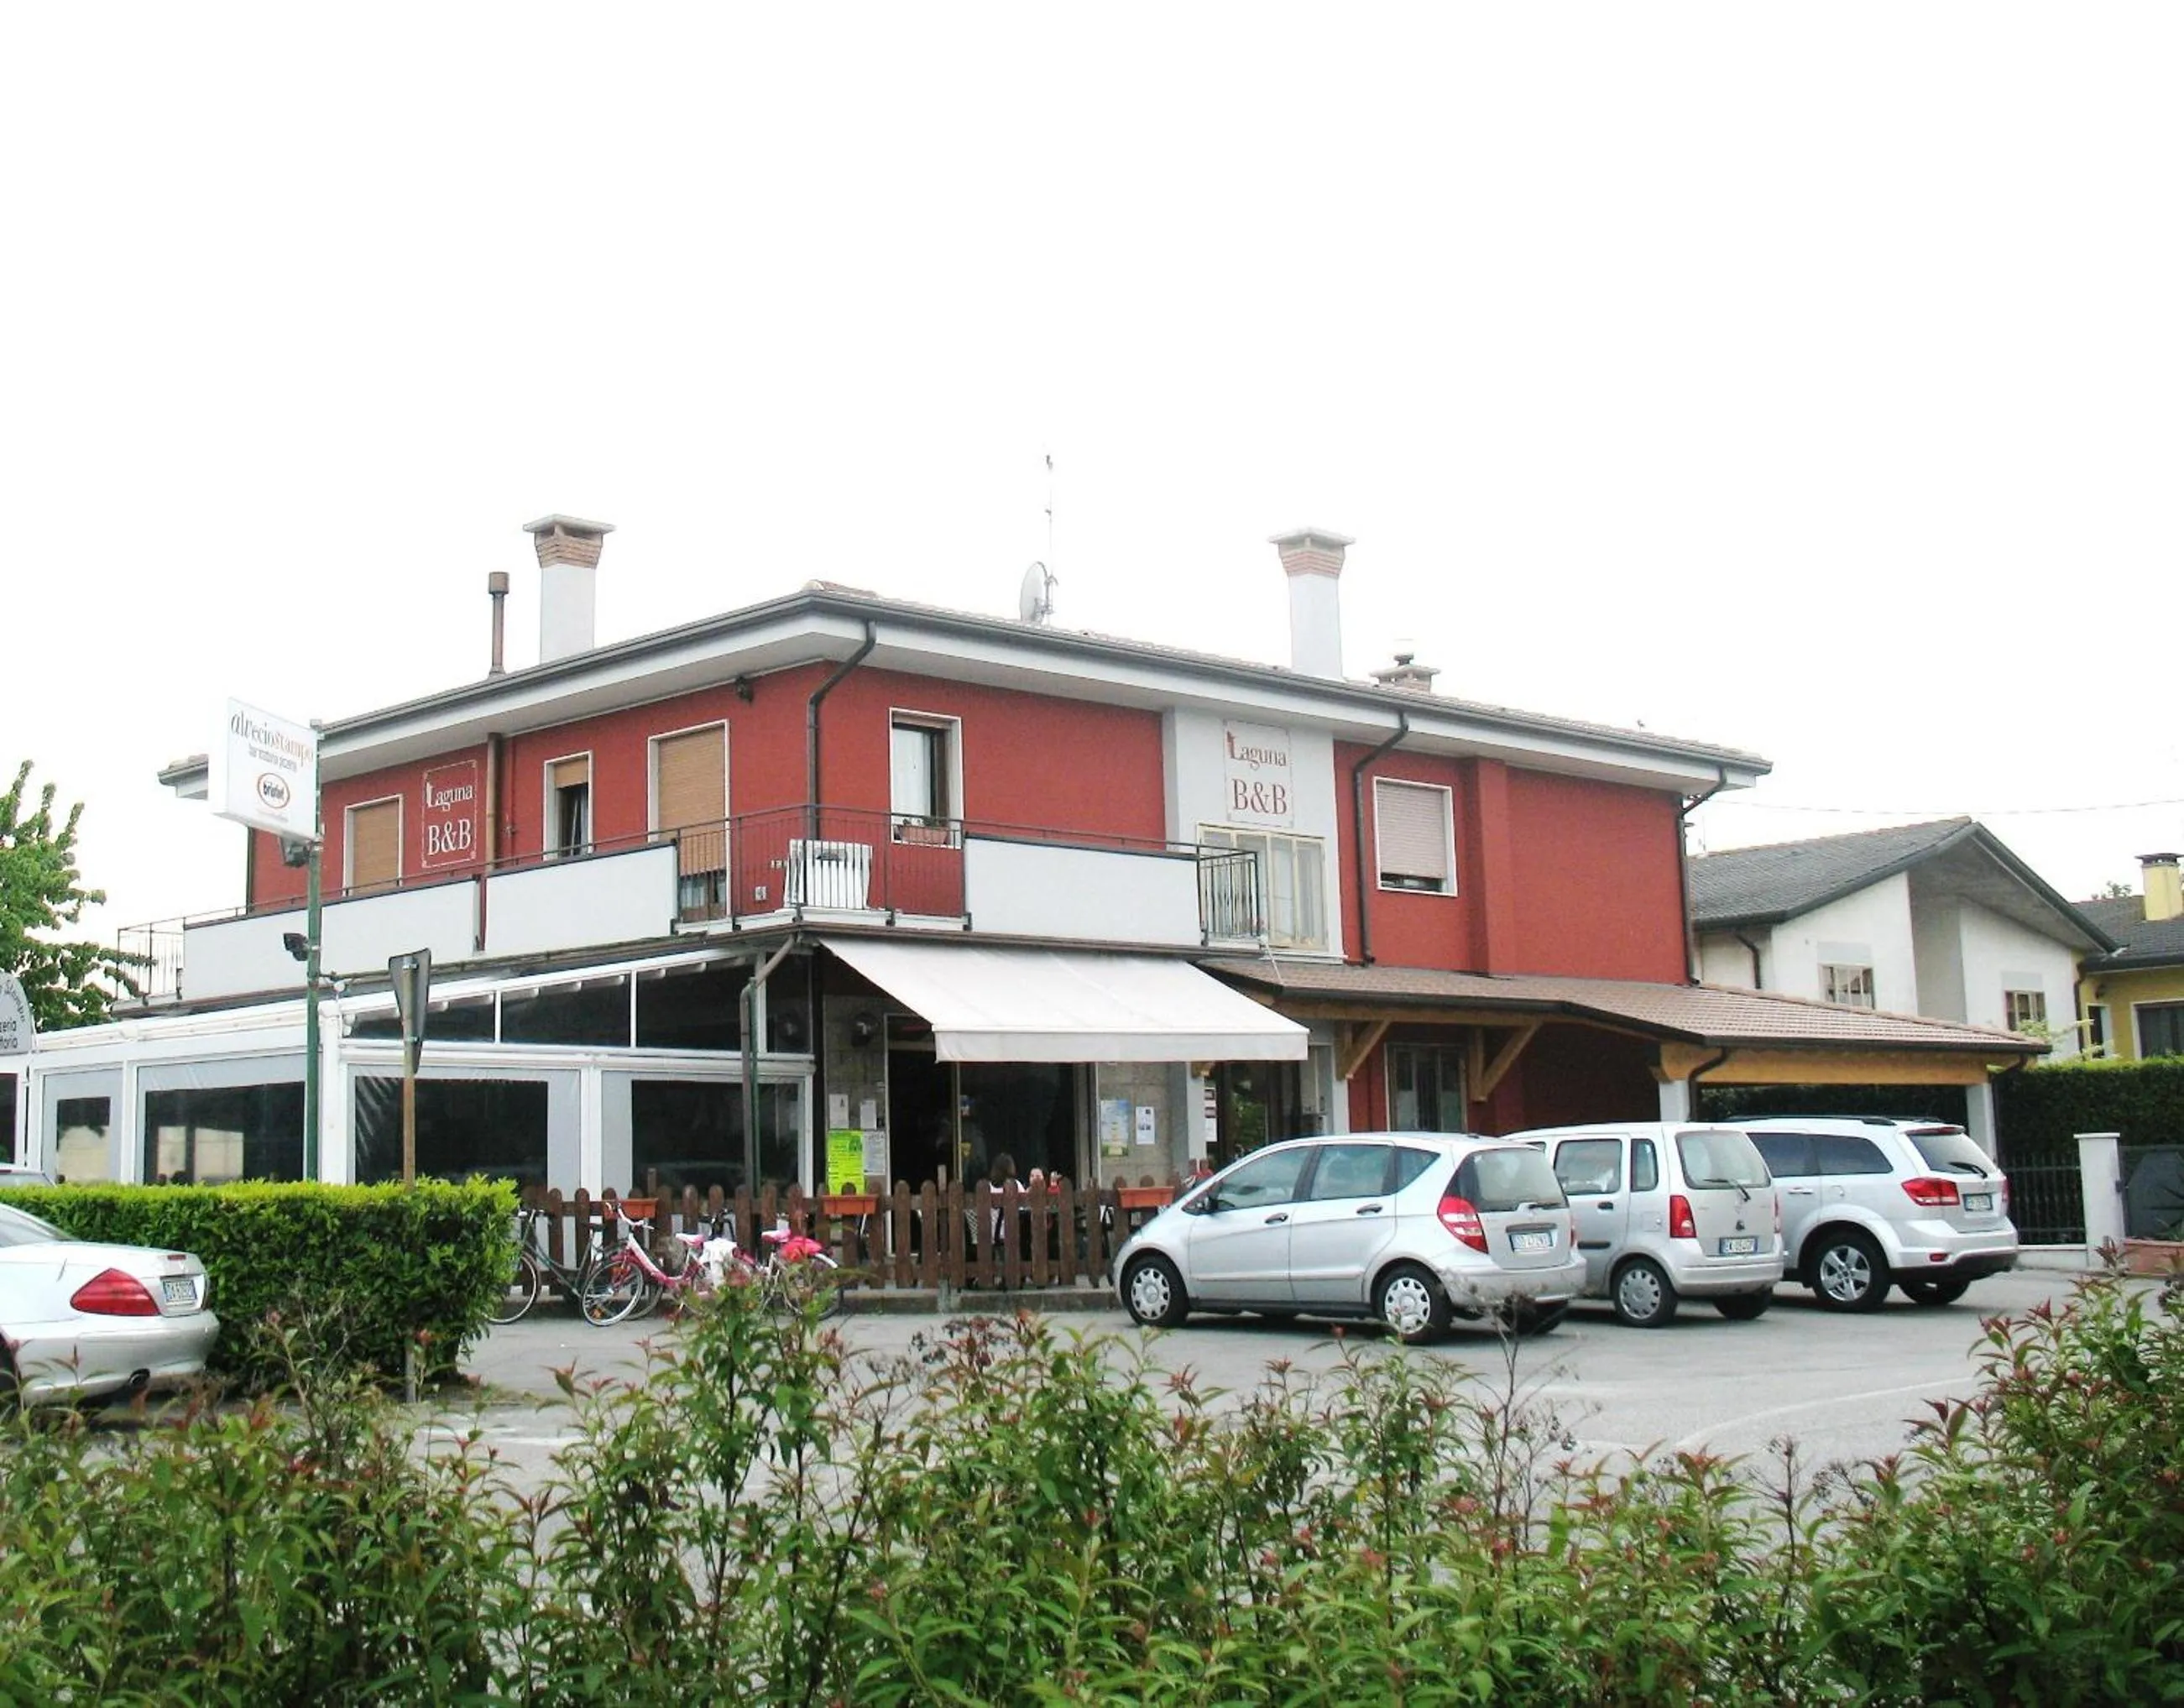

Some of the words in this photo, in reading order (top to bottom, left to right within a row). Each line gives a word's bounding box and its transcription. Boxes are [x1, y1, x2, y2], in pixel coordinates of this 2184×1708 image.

[1226, 730, 1287, 771] Laguna
[426, 781, 473, 812] Laguna
[1231, 778, 1288, 815] B&B
[427, 818, 472, 856] B&B
